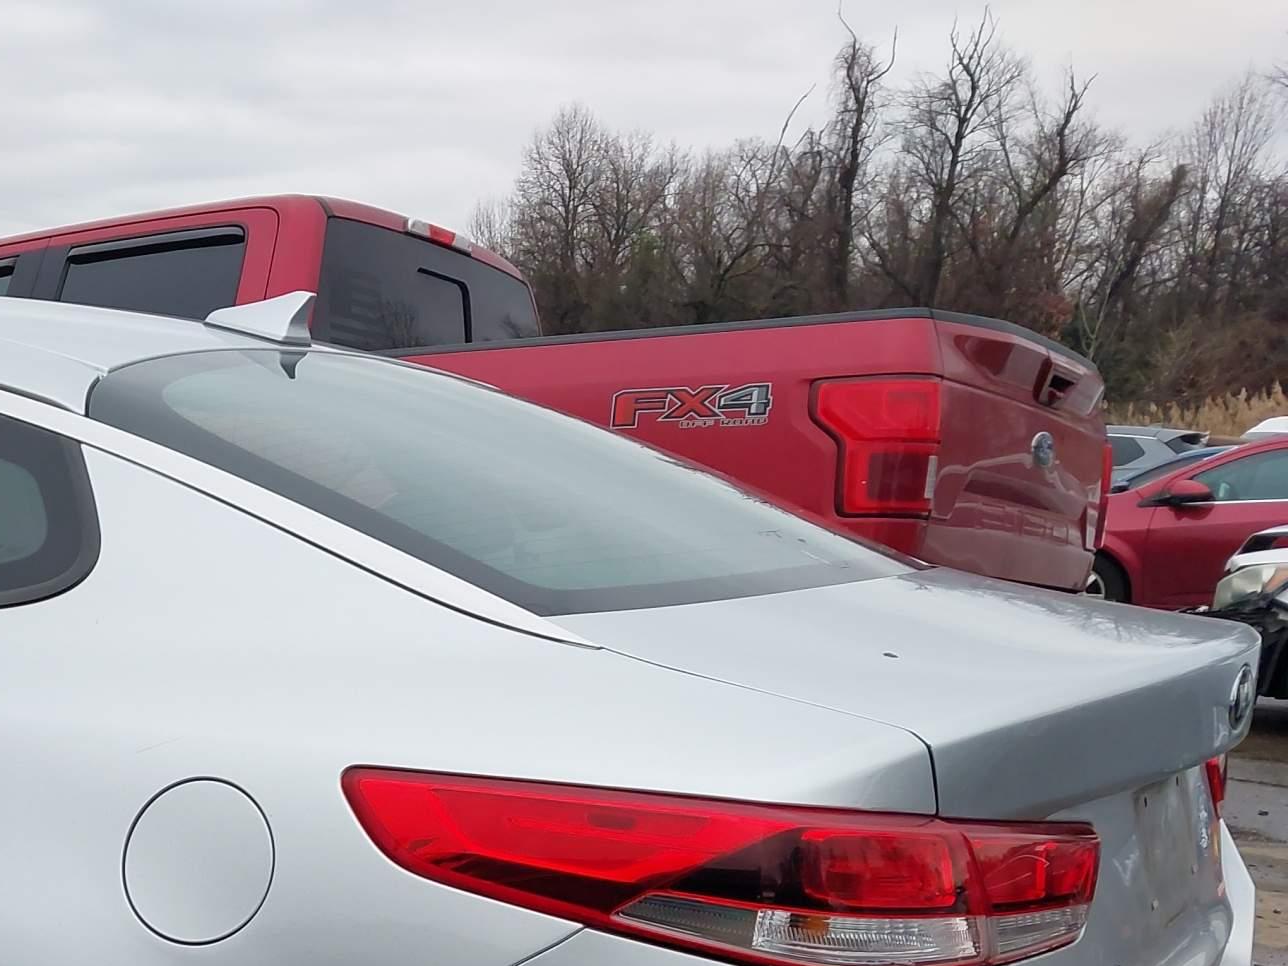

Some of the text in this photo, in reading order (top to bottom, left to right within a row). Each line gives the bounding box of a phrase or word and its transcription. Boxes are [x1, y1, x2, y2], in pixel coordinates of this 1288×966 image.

[611, 383, 772, 429] FX4
[679, 416, 768, 429] OFF ROAD
